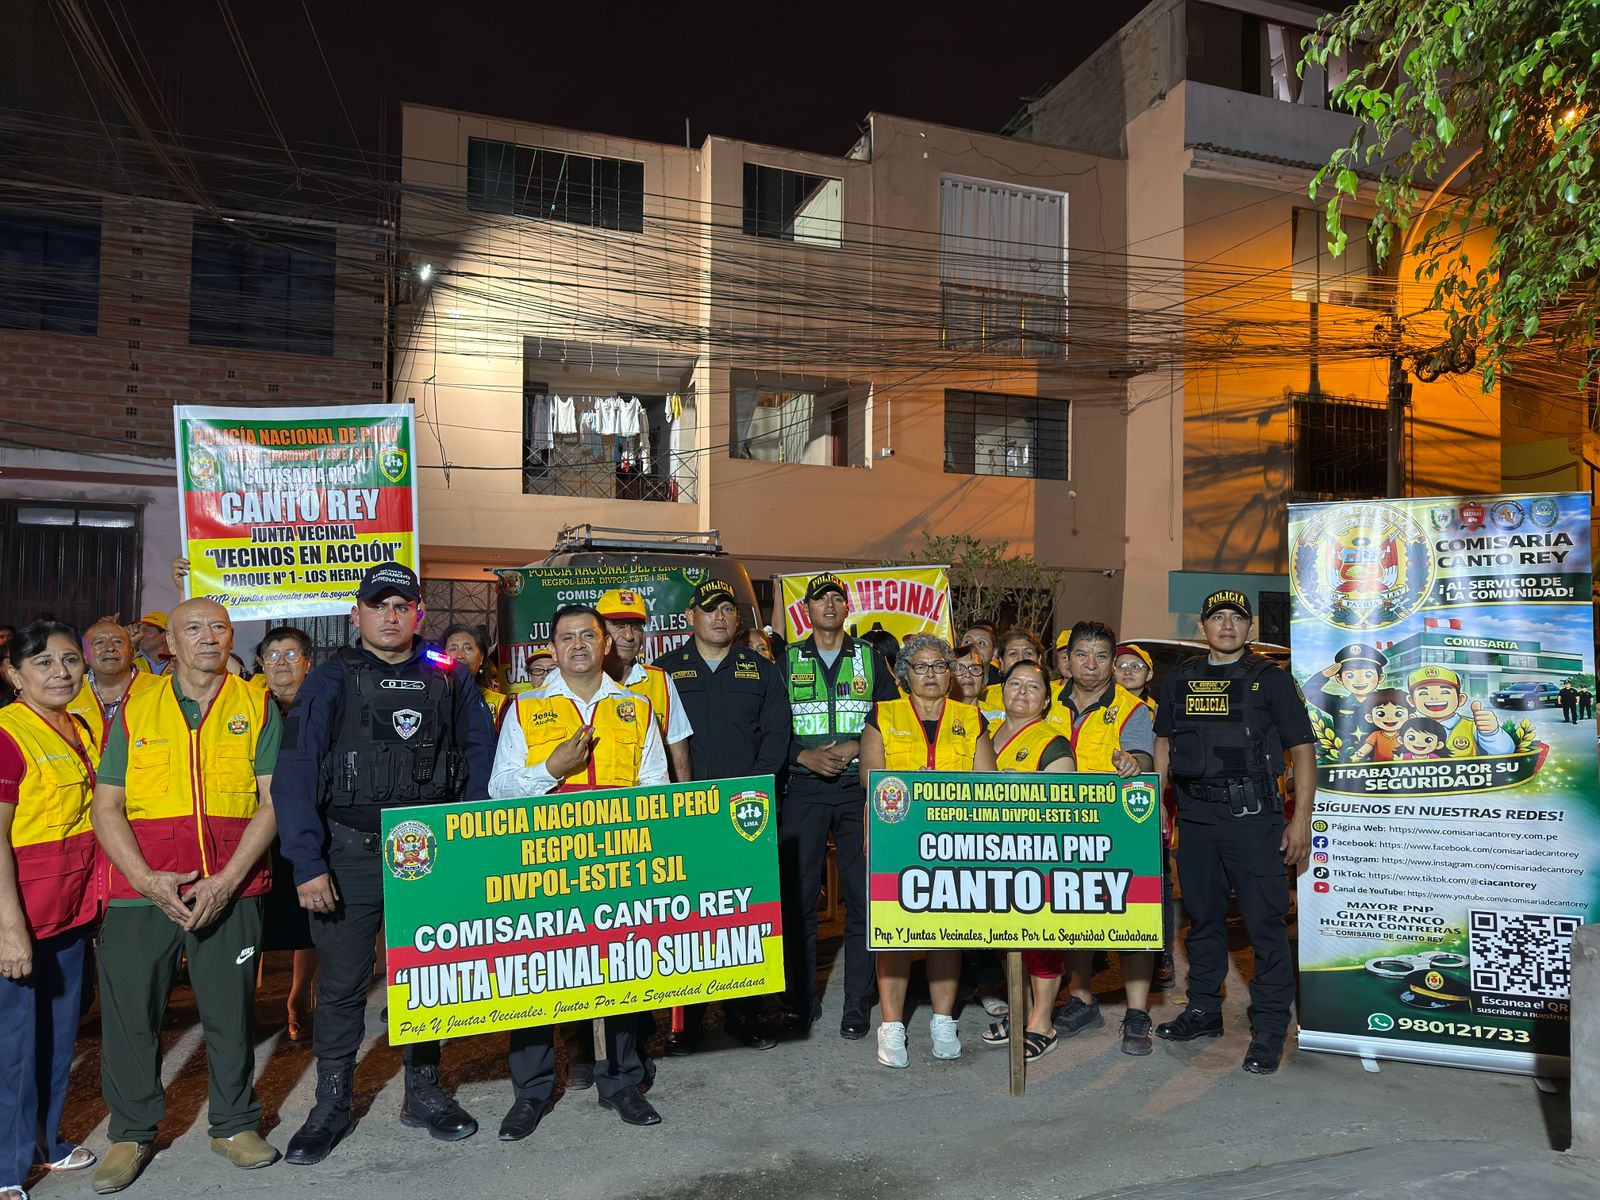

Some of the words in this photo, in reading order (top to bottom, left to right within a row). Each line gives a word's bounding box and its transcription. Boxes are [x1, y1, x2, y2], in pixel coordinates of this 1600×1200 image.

[193, 426, 257, 446] POLICÍA
[259, 428, 335, 445] NACIONAL
[338, 427, 357, 444] DE
[221, 488, 320, 524] CANTO
[326, 488, 379, 520] REY
[251, 526, 294, 543] JUNTA
[297, 524, 356, 541] VECINAL
[1435, 532, 1574, 553] COMISARIA
[299, 545, 321, 564] EN
[1437, 553, 1514, 568] CANTO
[1520, 550, 1570, 564] REY
[222, 572, 271, 587] PARQUE
[289, 570, 296, 584] 1
[305, 572, 327, 583] LOS
[575, 565, 628, 576] NACIONAL
[541, 577, 596, 587] REGPOL-LIMA
[700, 580, 735, 598] POLICIA
[811, 574, 845, 590] POLICIA
[1469, 577, 1537, 591] SERVICIO
[1541, 576, 1562, 587] DE
[238, 594, 264, 606] juntas
[265, 591, 302, 601] vecinales
[303, 591, 319, 600] por
[320, 590, 330, 599] la
[856, 579, 946, 622] VECINAL
[1208, 591, 1246, 607] POLICIA
[1446, 592, 1465, 601] LA
[1469, 587, 1575, 600] COMUNIDAD!
[1188, 697, 1227, 712] POLICIA
[1328, 764, 1452, 783] ¡TRABAJANDO
[1455, 763, 1493, 775] POR
[1495, 761, 1520, 773] SU
[1365, 773, 1493, 792] SEGURIDAD!
[913, 781, 972, 803] POLICIA
[974, 783, 1048, 803] NACIONAL
[1050, 784, 1076, 803] DEL
[1078, 781, 1117, 804] PERÚ
[446, 806, 530, 841] POLICIA
[533, 797, 632, 832] NACIONAL
[635, 794, 669, 821] DEL
[672, 785, 721, 818] PERÚ
[926, 807, 1000, 822] REGPOL-LIMA
[1073, 809, 1080, 823] 1
[1081, 809, 1100, 823] SJL
[1394, 804, 1415, 816] EN
[1418, 805, 1502, 820] NUESTRAS
[1505, 809, 1565, 821] REDES!
[1331, 822, 1361, 833] Página
[1363, 824, 1387, 833] Web:
[1389, 825, 1559, 841] https://www.comisariacantorey.com.pe
[521, 827, 653, 867] REGPOL-LIMA
[918, 832, 1059, 863] COMISARIA
[1062, 834, 1112, 863] PNP
[1332, 838, 1378, 848] Facebook:
[1379, 840, 1580, 860] https://www.facebook.com/comisariadecantorey
[1332, 853, 1380, 864] Instagram:
[1381, 856, 1585, 877] https://www.instagram.com/comisariadecantorey
[485, 859, 631, 904] DIVPOL-ESTE
[635, 858, 648, 885] 1
[651, 855, 688, 885] SJL
[1332, 869, 1367, 879] TikTok:
[1368, 871, 1538, 891] https://www.tiktok.com/@ciacantorey
[899, 867, 1045, 913] CANTO
[1053, 869, 1132, 912] REY
[1333, 884, 1357, 894] Canal
[1357, 886, 1368, 894] de
[1369, 887, 1406, 897] YouTube:
[1346, 901, 1399, 912] MAYOR
[1402, 904, 1435, 913] PNP
[413, 907, 586, 953] COMISARIA
[593, 893, 691, 931] CANTO
[699, 886, 754, 917] REY
[1320, 918, 1375, 929] HUERTA
[1377, 921, 1462, 935] CONTRERAS
[1336, 910, 1445, 926] GIANFRANCO
[874, 927, 893, 944] Pnp
[896, 928, 905, 941] Y
[902, 927, 937, 944] Juntas
[939, 928, 986, 943] Vecinales,
[985, 928, 1019, 944] Juntos
[1021, 928, 1040, 942] Por
[1042, 928, 1057, 942] La
[1058, 928, 1106, 945] Seguridad
[1107, 928, 1160, 943] Ciudadana
[1336, 930, 1381, 939] COMISARIO
[1383, 932, 1394, 940] DE
[1396, 934, 1425, 942] CANTO
[494, 943, 604, 999] VECINAL
[607, 932, 656, 984] RÍO
[400, 1021, 427, 1036] Pnp
[429, 1017, 443, 1034] Y
[446, 1013, 487, 1033] Juntas
[488, 1006, 548, 1024] Vecinales,
[553, 1000, 589, 1019] Juntos
[594, 994, 616, 1010] Por
[620, 991, 638, 1005] La
[642, 983, 703, 1004] Seguridad
[706, 976, 767, 996] Ciudadana
[1476, 1006, 1522, 1017] suscribete
[1530, 1011, 1563, 1021] nuestro
[1481, 995, 1532, 1010] Escanea
[1534, 1000, 1545, 1010] el
[1547, 1002, 1569, 1013] QR
[1397, 1017, 1531, 1044] 980121733
